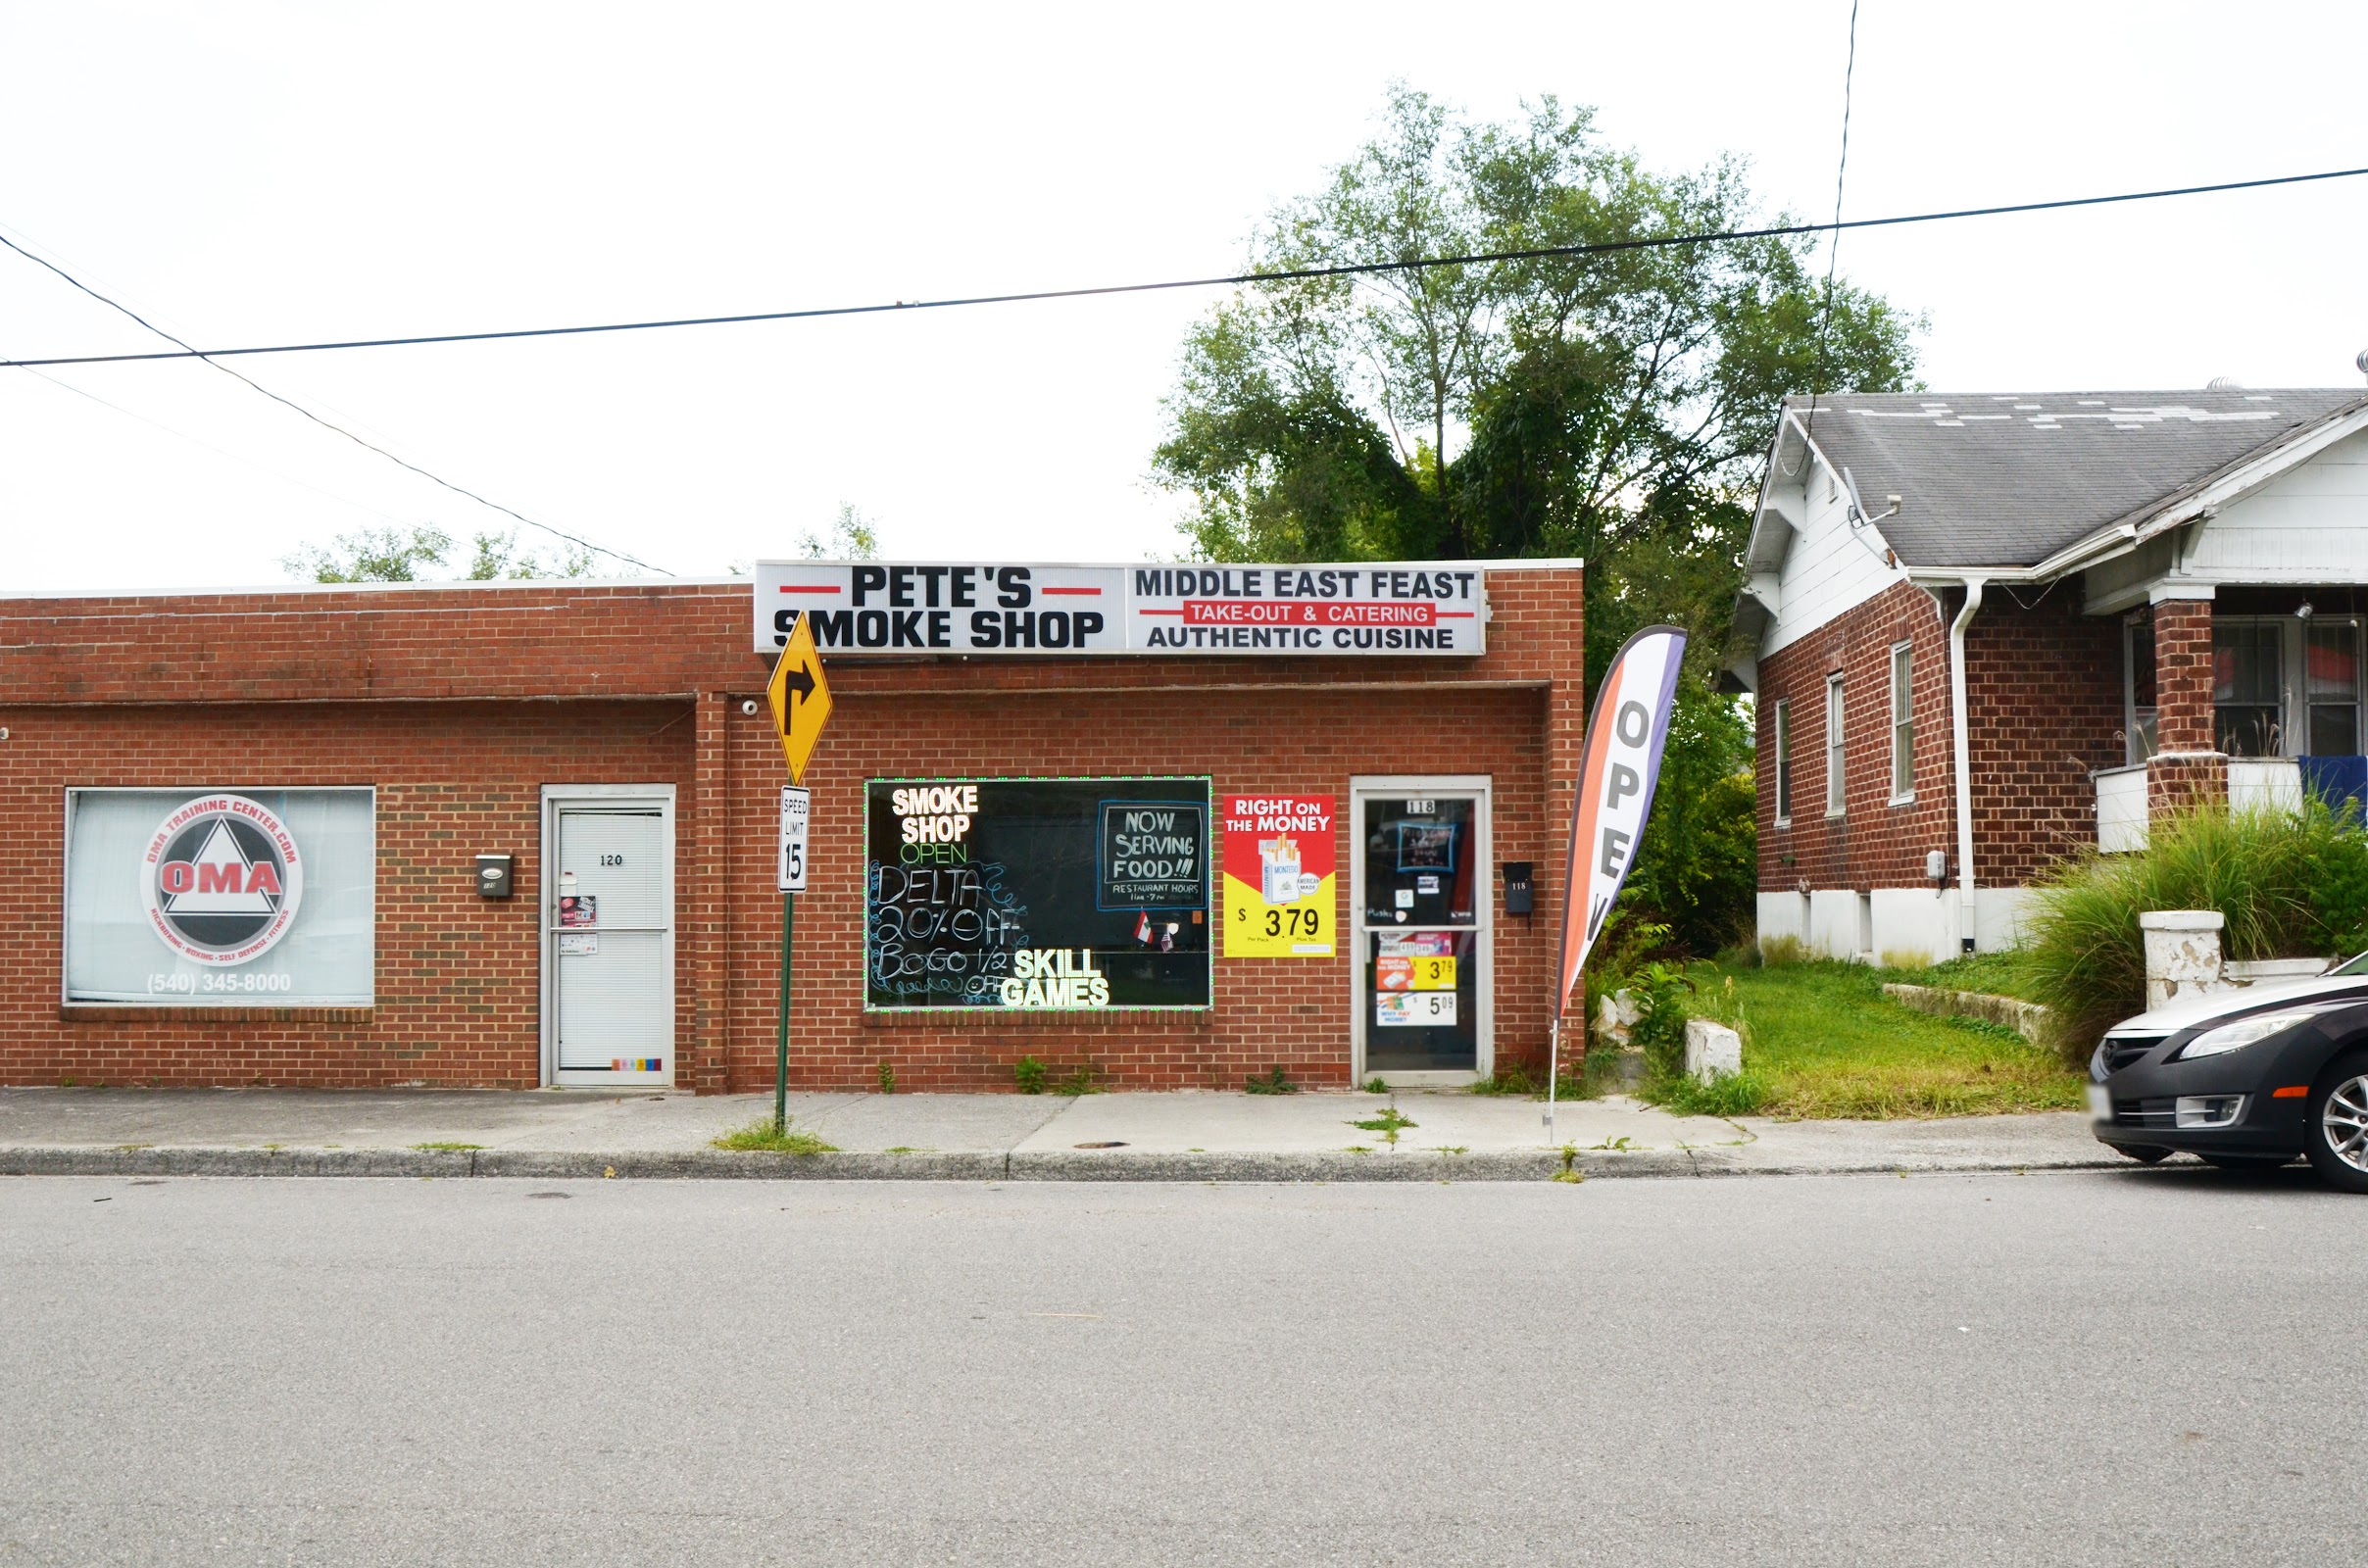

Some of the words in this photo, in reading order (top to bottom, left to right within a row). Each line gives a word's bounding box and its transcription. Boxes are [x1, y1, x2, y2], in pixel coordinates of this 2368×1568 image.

[852, 565, 1031, 608] PETE'S
[1136, 569, 1261, 597] MIDDLE
[1274, 571, 1359, 598] EAST
[1371, 572, 1474, 599] FEAST
[1191, 605, 1293, 621] TAKE-OUT
[1303, 606, 1316, 621] &
[1328, 606, 1428, 622] CATERING
[774, 610, 950, 647] SMOKE
[970, 611, 1104, 648] SHOP
[1147, 627, 1322, 648] AUTHENTIC
[1333, 628, 1454, 649] CUISINE
[784, 799, 808, 814] SPEED
[892, 786, 978, 815] SMOKE
[1235, 799, 1294, 815] RIGHT
[1296, 803, 1321, 815] ON
[1410, 801, 1433, 812] 118
[147, 832, 168, 863] OMA
[165, 800, 227, 832] TRAINING
[232, 801, 297, 863] CENTER.COM
[785, 821, 804, 836] LIMIT
[901, 814, 970, 844] SHOP
[1125, 811, 1175, 833] NOW
[1225, 819, 1253, 832] THE
[1257, 815, 1331, 832] MONEY
[900, 843, 966, 863] OPEN
[1115, 833, 1194, 858] SERVING
[600, 855, 622, 865] 120
[786, 844, 801, 880] 15
[162, 861, 282, 894] OMA
[878, 865, 985, 908] DELTA
[1112, 884, 1168, 893] RESTAURANT
[1171, 884, 1199, 893] HOURS
[877, 906, 949, 944] 20%
[1238, 907, 1246, 922] $
[151, 907, 183, 949] KICKBOXING
[185, 948, 214, 960] BOXING
[238, 938, 268, 957] DEFENSE
[269, 908, 289, 938] FITNESS
[877, 943, 967, 980] BOGO
[978, 946, 1008, 973] 1/2
[1013, 949, 1102, 978] SKILL
[147, 973, 196, 995] (540)
[203, 973, 291, 992] 345-8000
[1000, 977, 1110, 1006] GAMES
